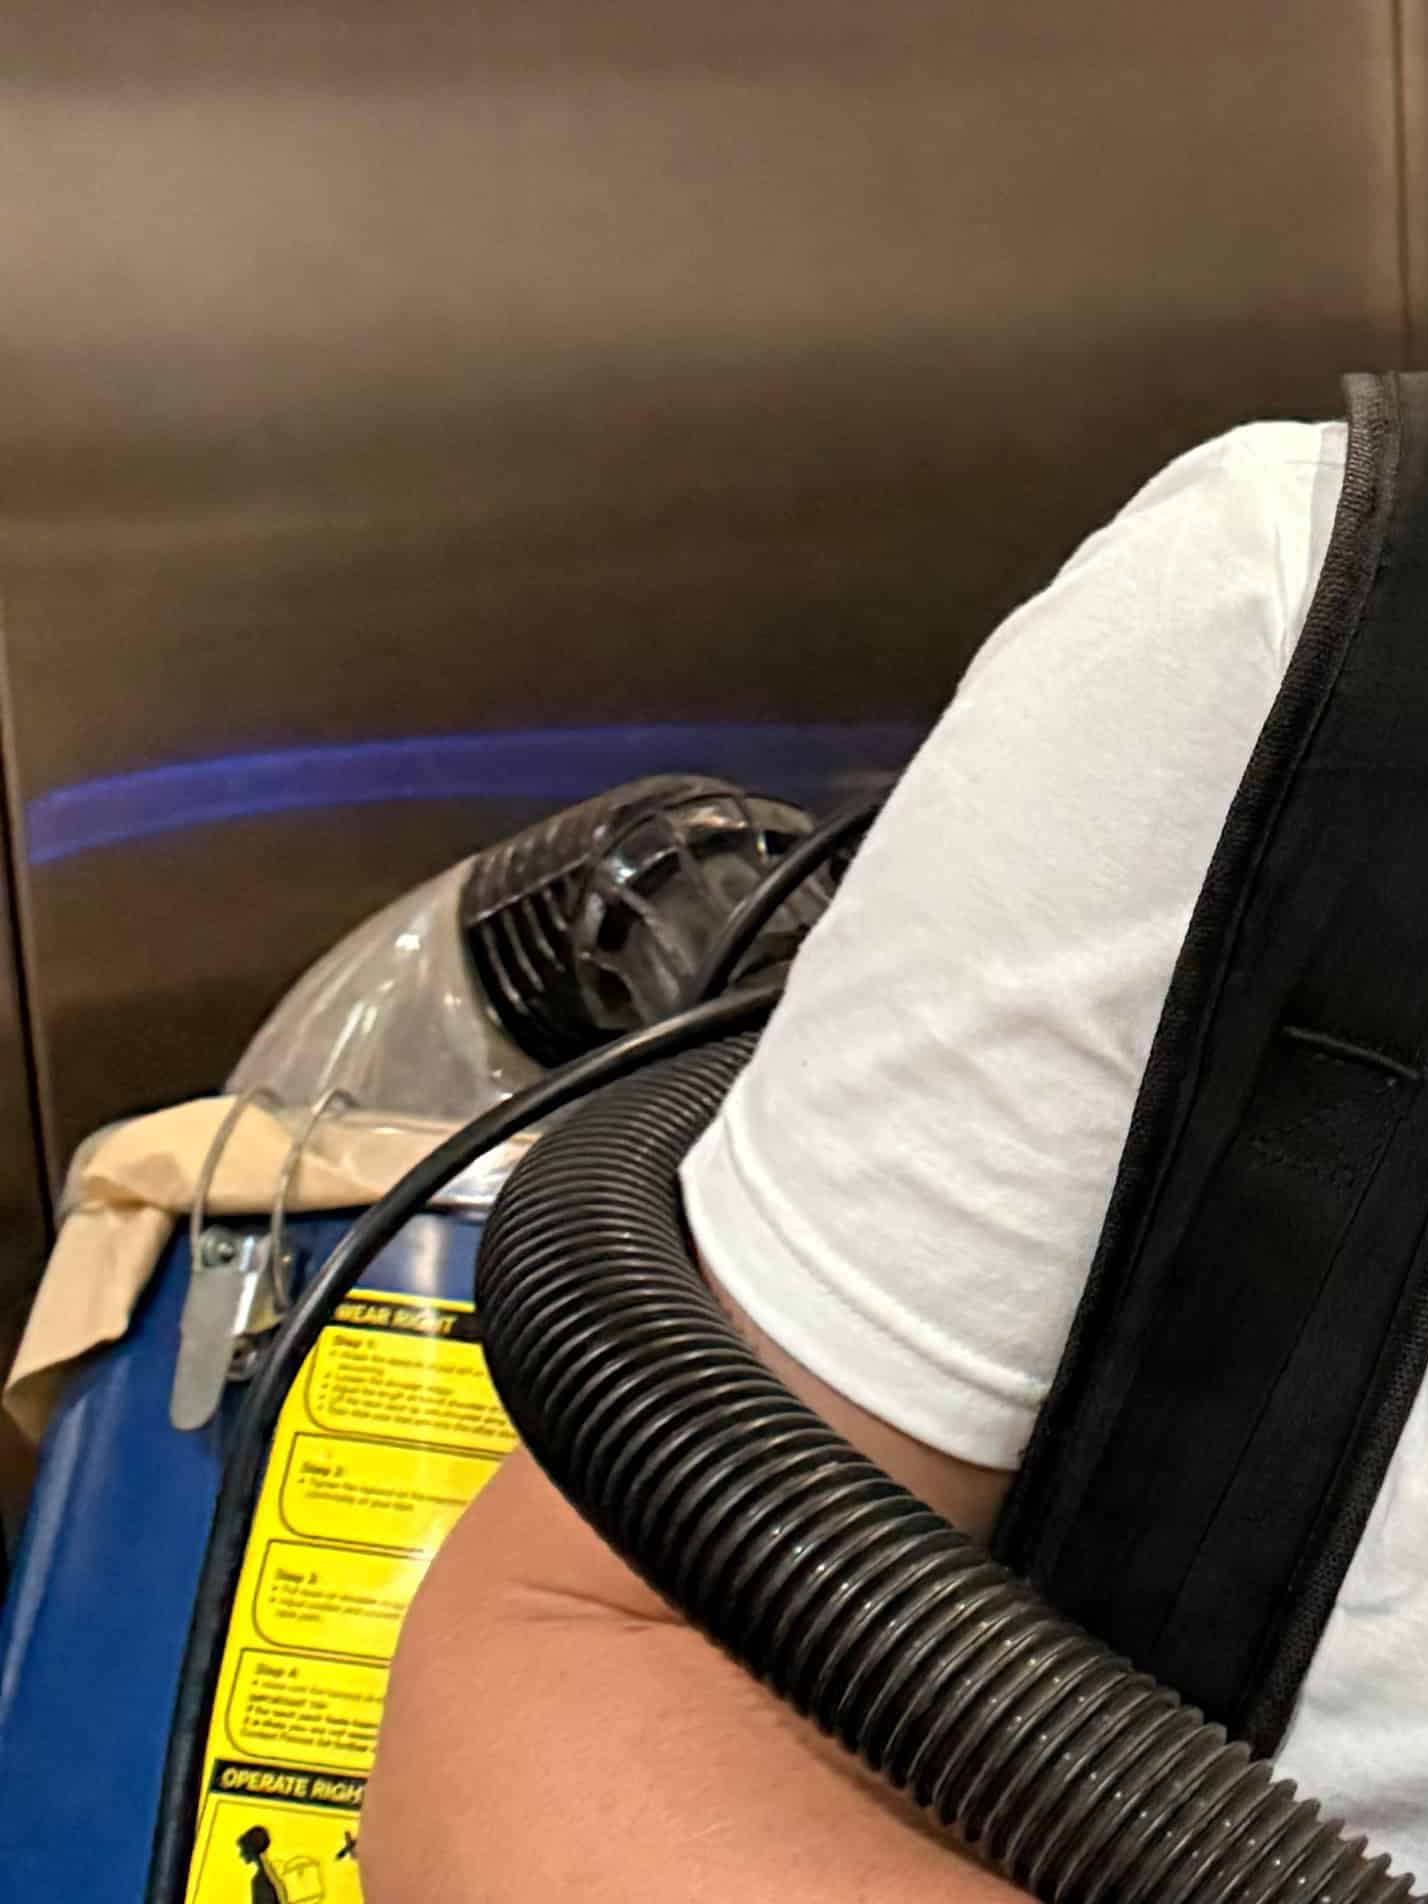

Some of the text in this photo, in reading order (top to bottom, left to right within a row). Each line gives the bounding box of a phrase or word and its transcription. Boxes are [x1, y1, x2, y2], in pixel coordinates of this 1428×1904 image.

[333, 1302, 391, 1326] WEAR
[220, 1767, 364, 1805] OPERATE RIGH
